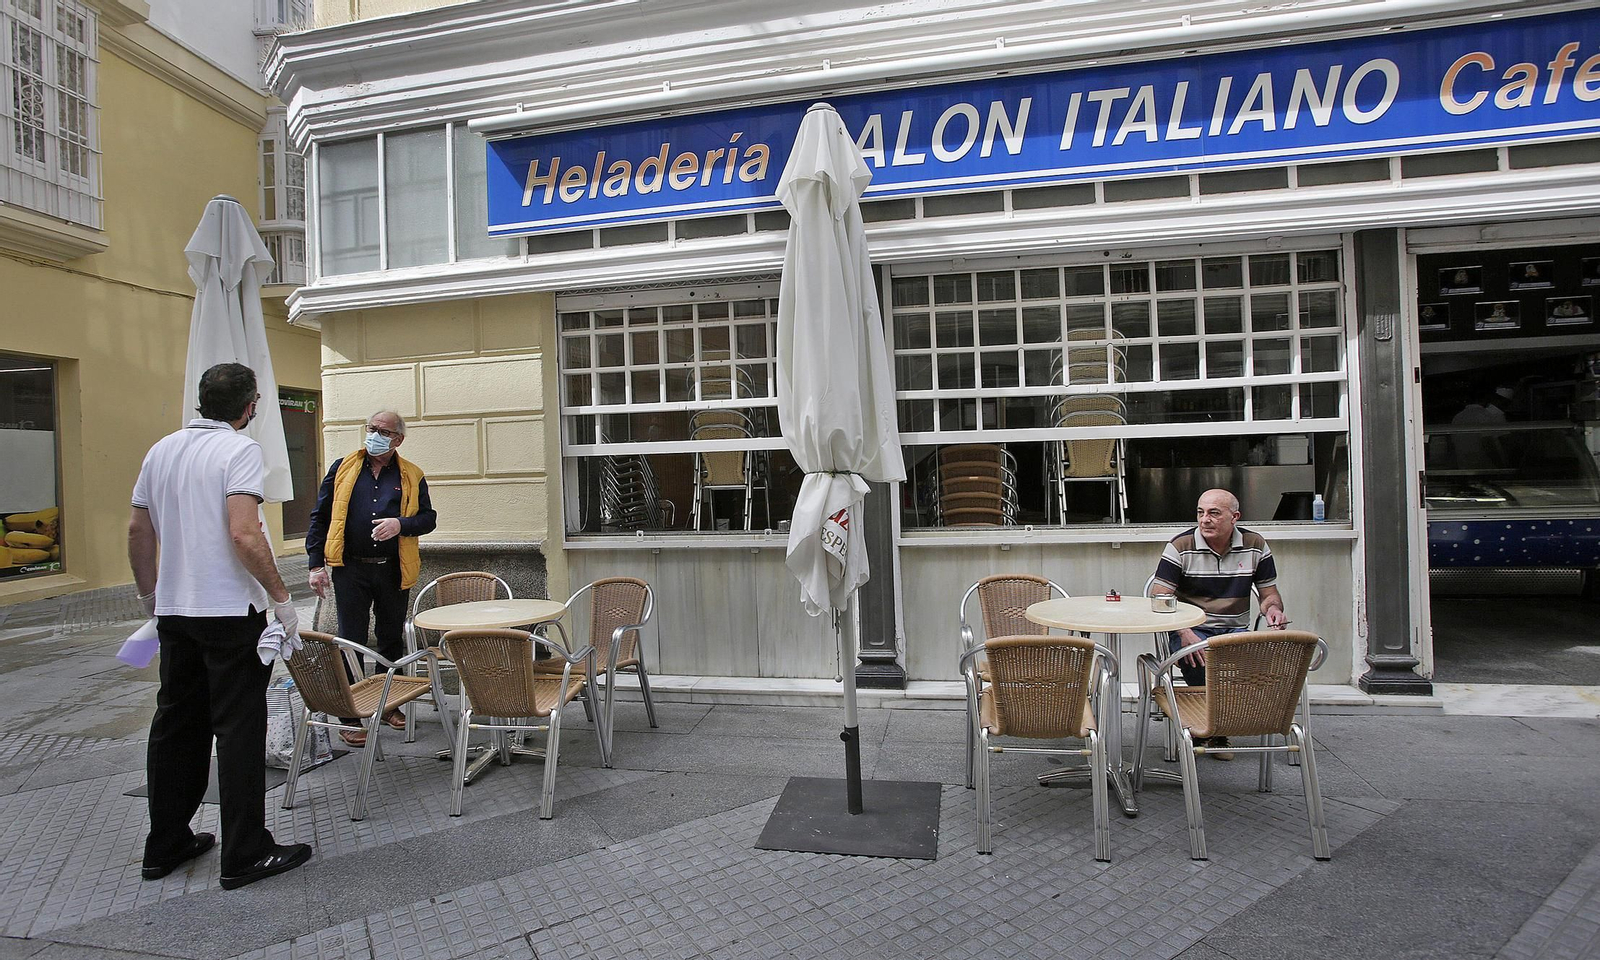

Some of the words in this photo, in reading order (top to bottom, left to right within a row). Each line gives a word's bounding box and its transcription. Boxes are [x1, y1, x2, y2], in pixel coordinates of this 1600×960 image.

[520, 132, 771, 207] Heladería
[855, 97, 1033, 168] ALON
[1059, 58, 1401, 151] ITALIANO
